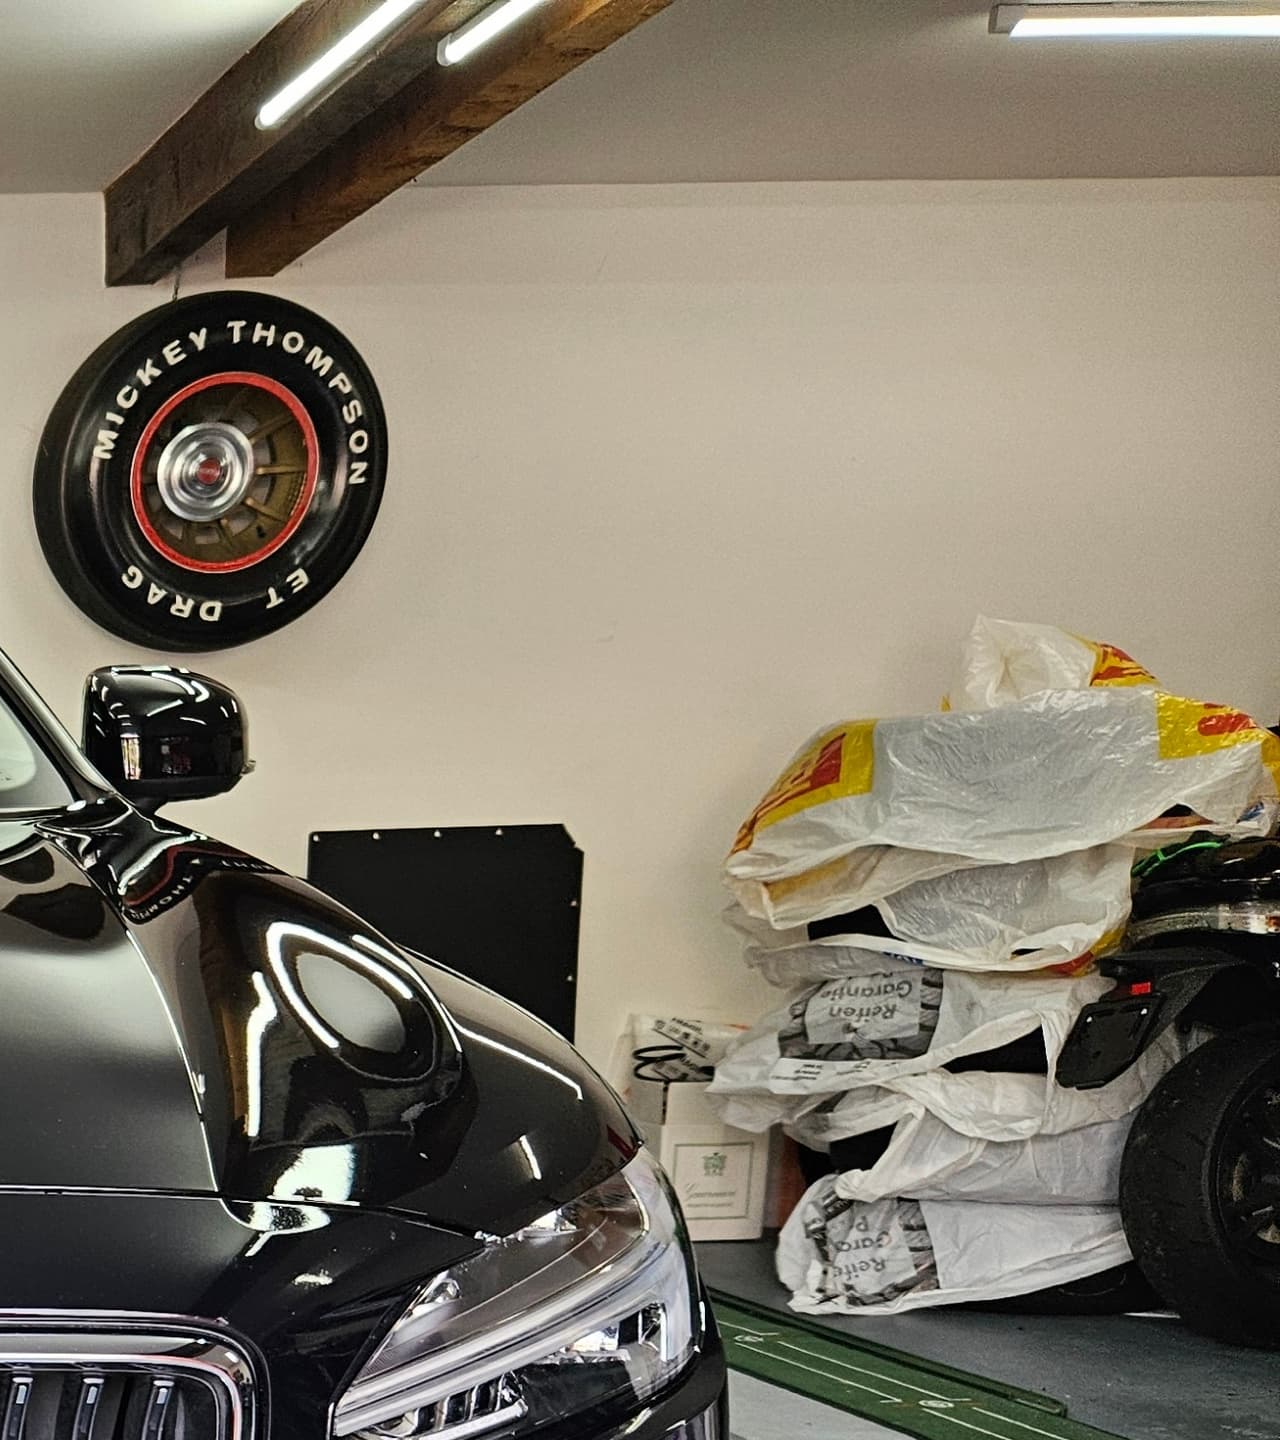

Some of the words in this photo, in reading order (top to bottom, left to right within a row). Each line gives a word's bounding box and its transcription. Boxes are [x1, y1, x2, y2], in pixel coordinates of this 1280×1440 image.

[93, 327, 208, 460] MICKEY
[226, 320, 370, 485] THOMPSON
[121, 564, 223, 622] DRAG
[265, 567, 311, 609] ET
[828, 1003, 897, 1023] Reifen
